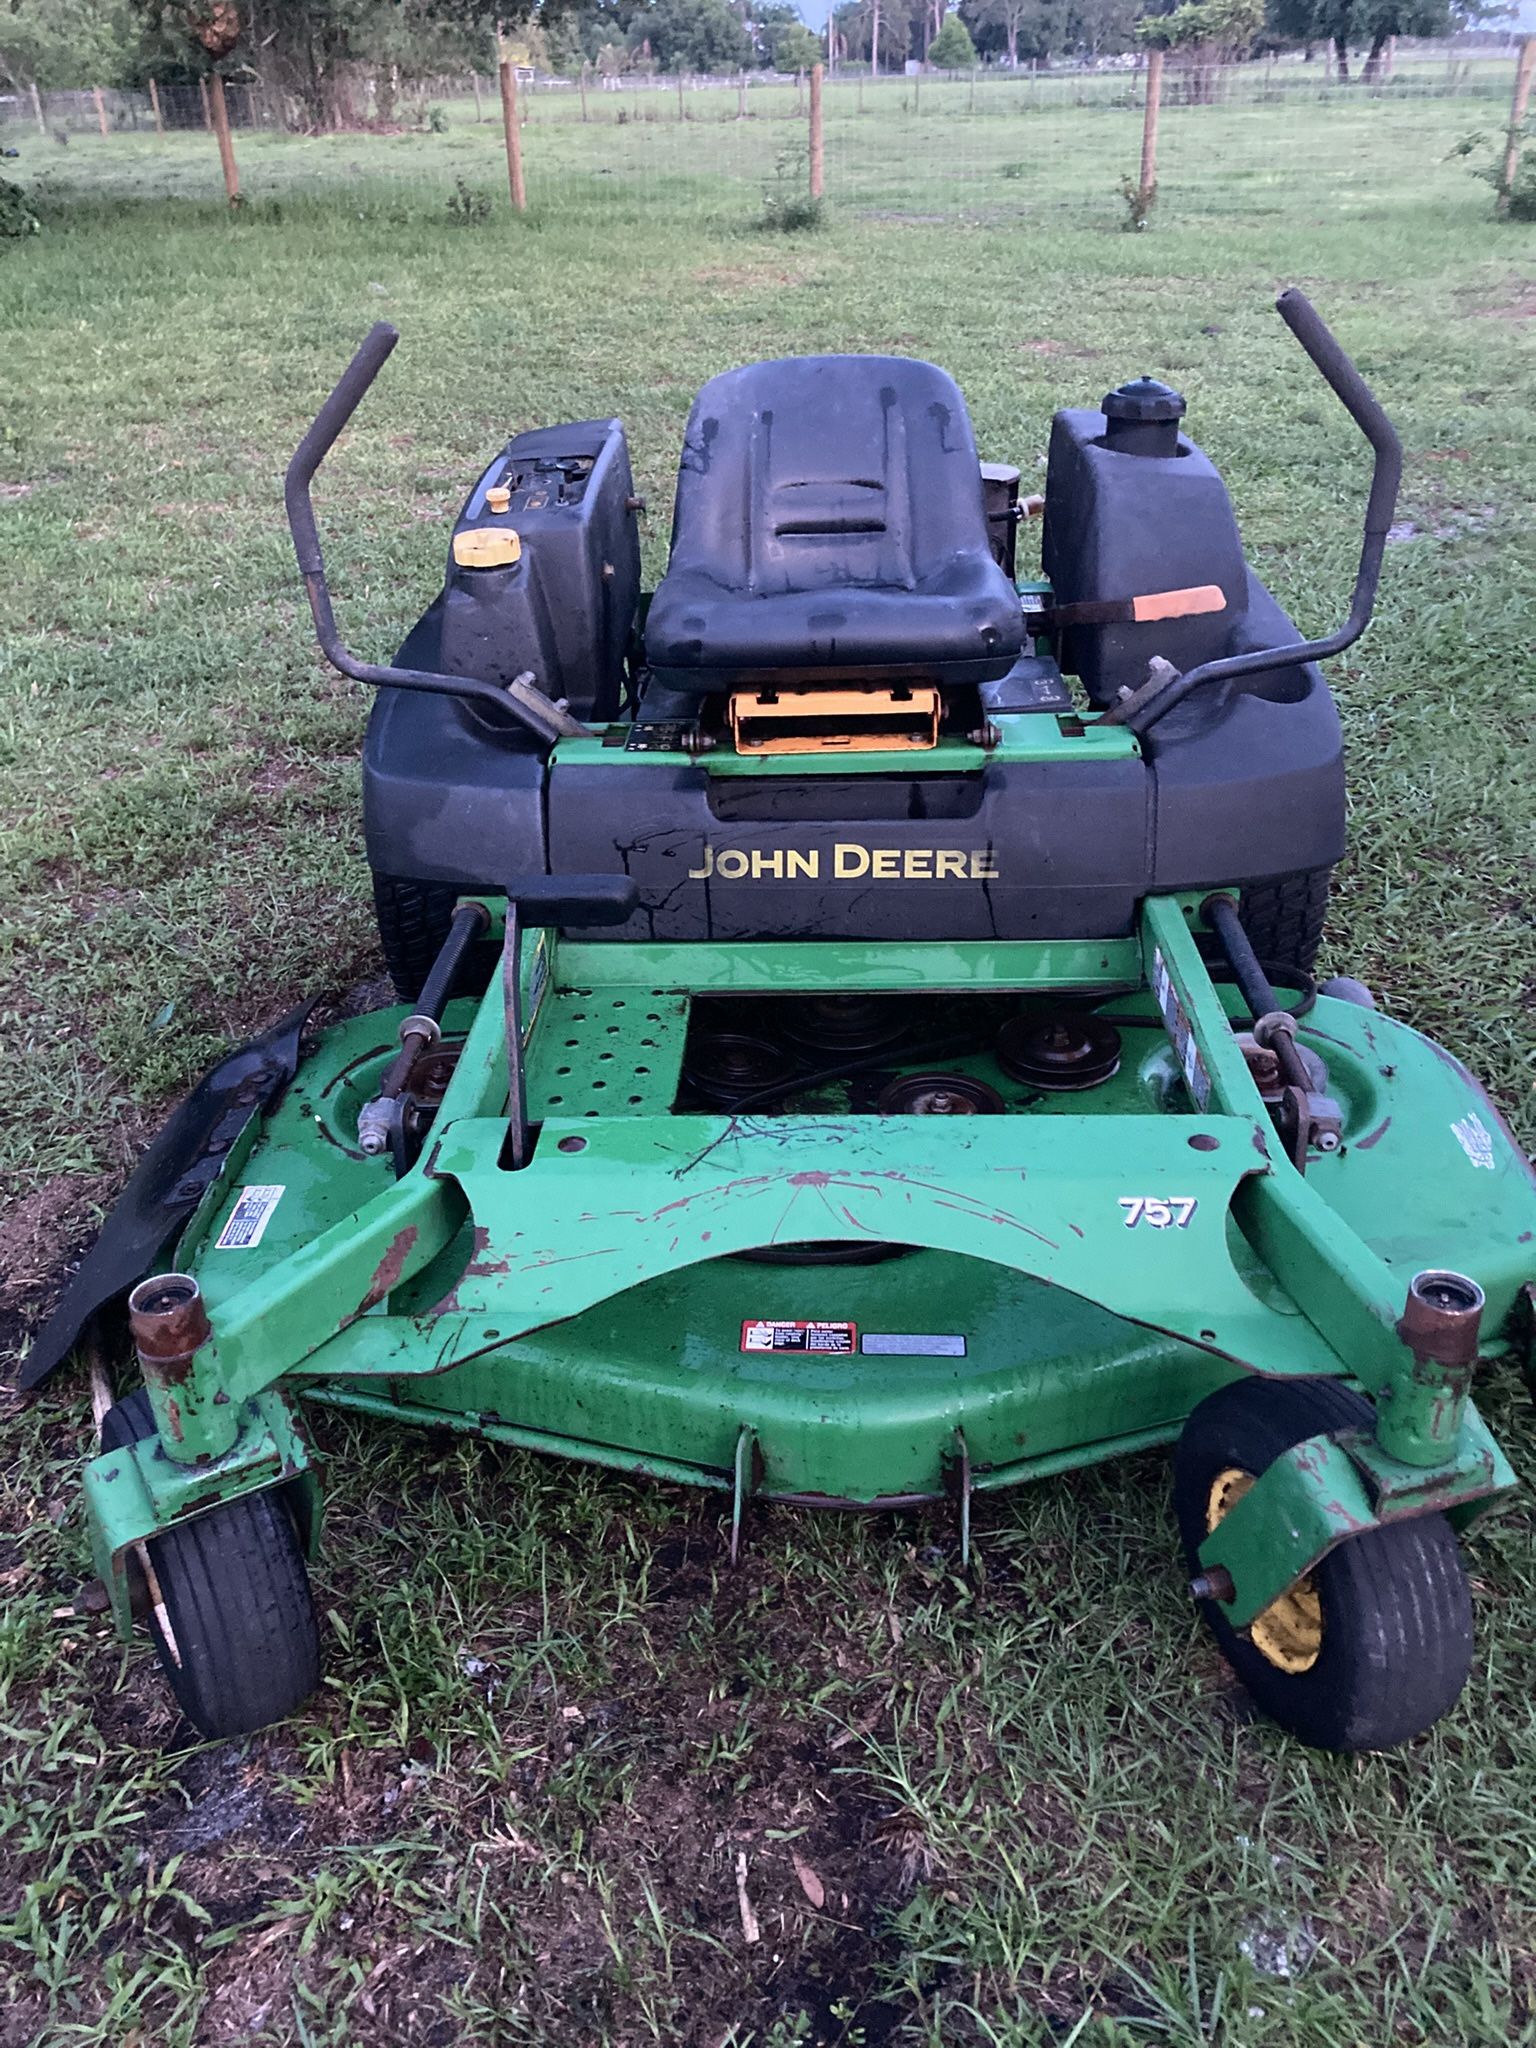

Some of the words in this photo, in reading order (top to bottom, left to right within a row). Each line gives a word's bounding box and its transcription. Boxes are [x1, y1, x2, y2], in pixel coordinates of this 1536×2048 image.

[688, 843, 819, 880] JOHN
[834, 843, 1000, 880] DEERE
[1117, 1196, 1199, 1230] 757
